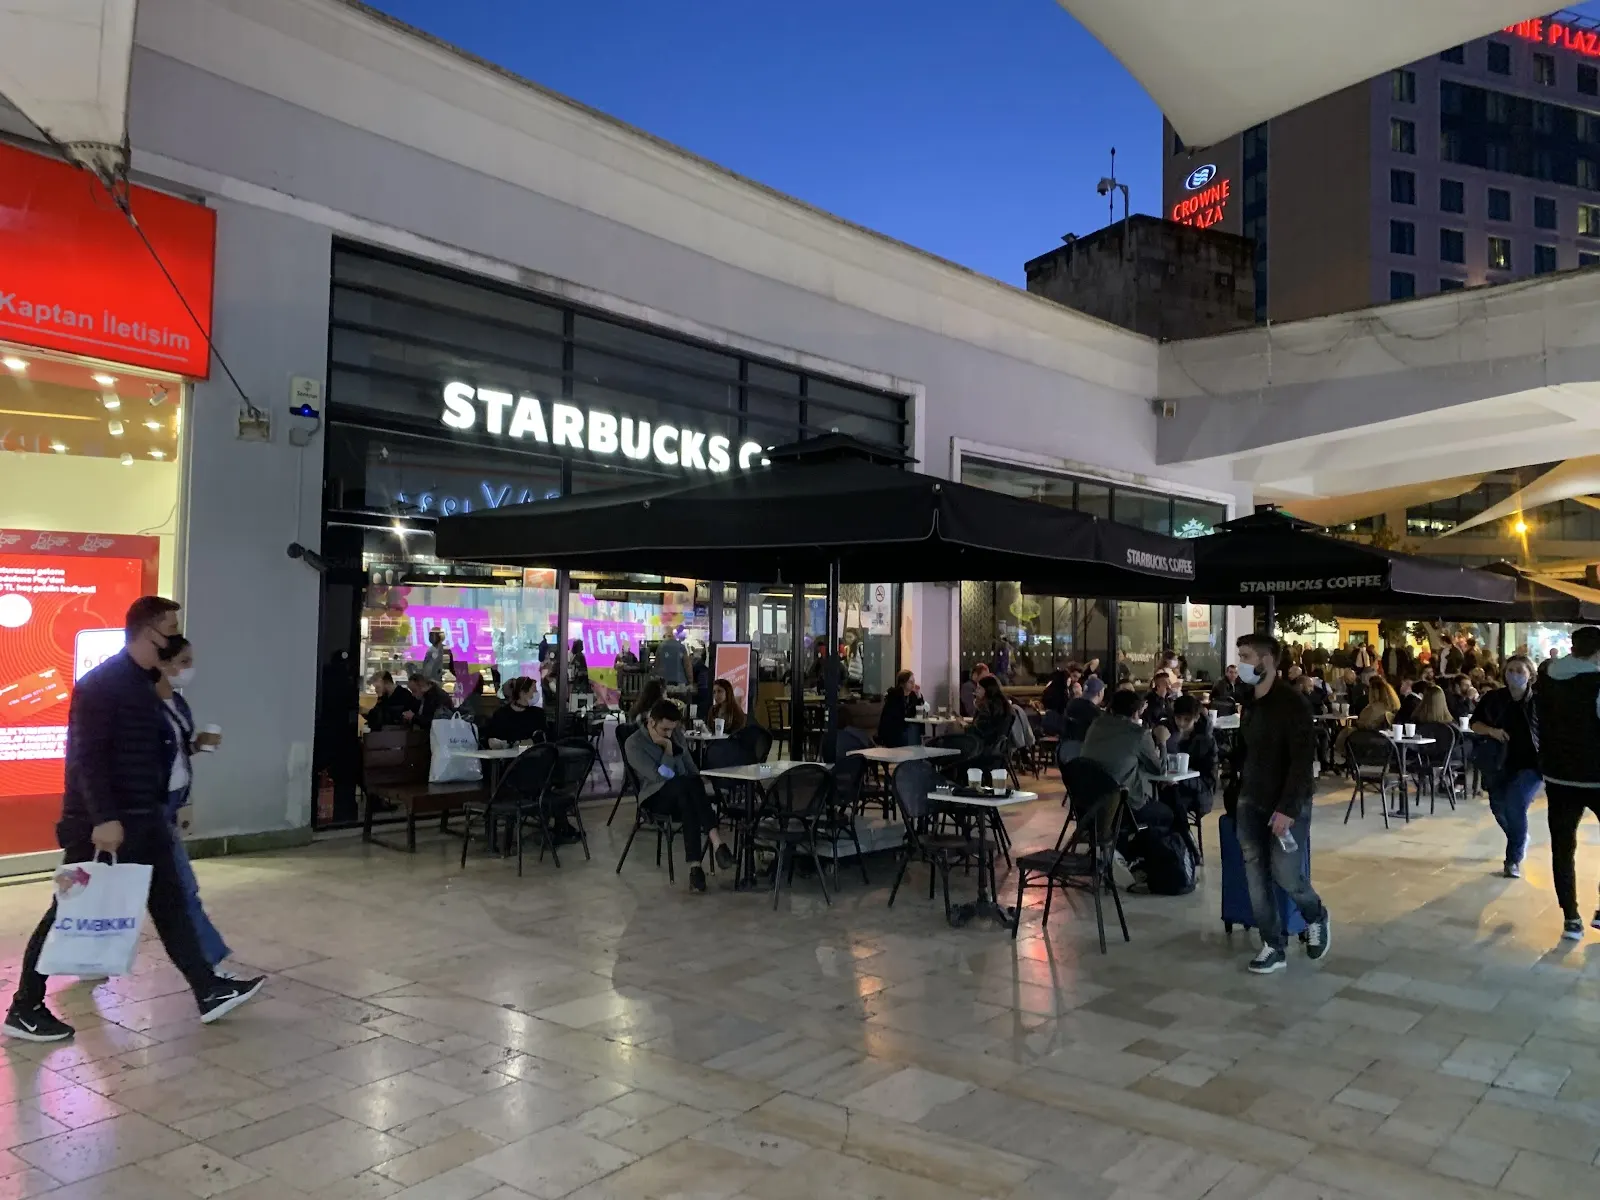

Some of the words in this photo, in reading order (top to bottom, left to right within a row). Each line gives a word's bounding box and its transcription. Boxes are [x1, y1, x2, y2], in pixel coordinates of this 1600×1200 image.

[1503, 18, 1543, 42] NE
[1549, 23, 1600, 56] PLAZ
[1173, 179, 1230, 222] CROWNE
[1182, 204, 1224, 229] AZA
[0, 290, 94, 330] Kaptan
[441, 381, 731, 473] STARBUCKS
[739, 441, 776, 469] C
[1126, 548, 1169, 572] STARBUCKS
[1168, 557, 1193, 574] COFFEE
[1239, 580, 1323, 593] STARBUCKS
[1326, 574, 1382, 589] COFFEE
